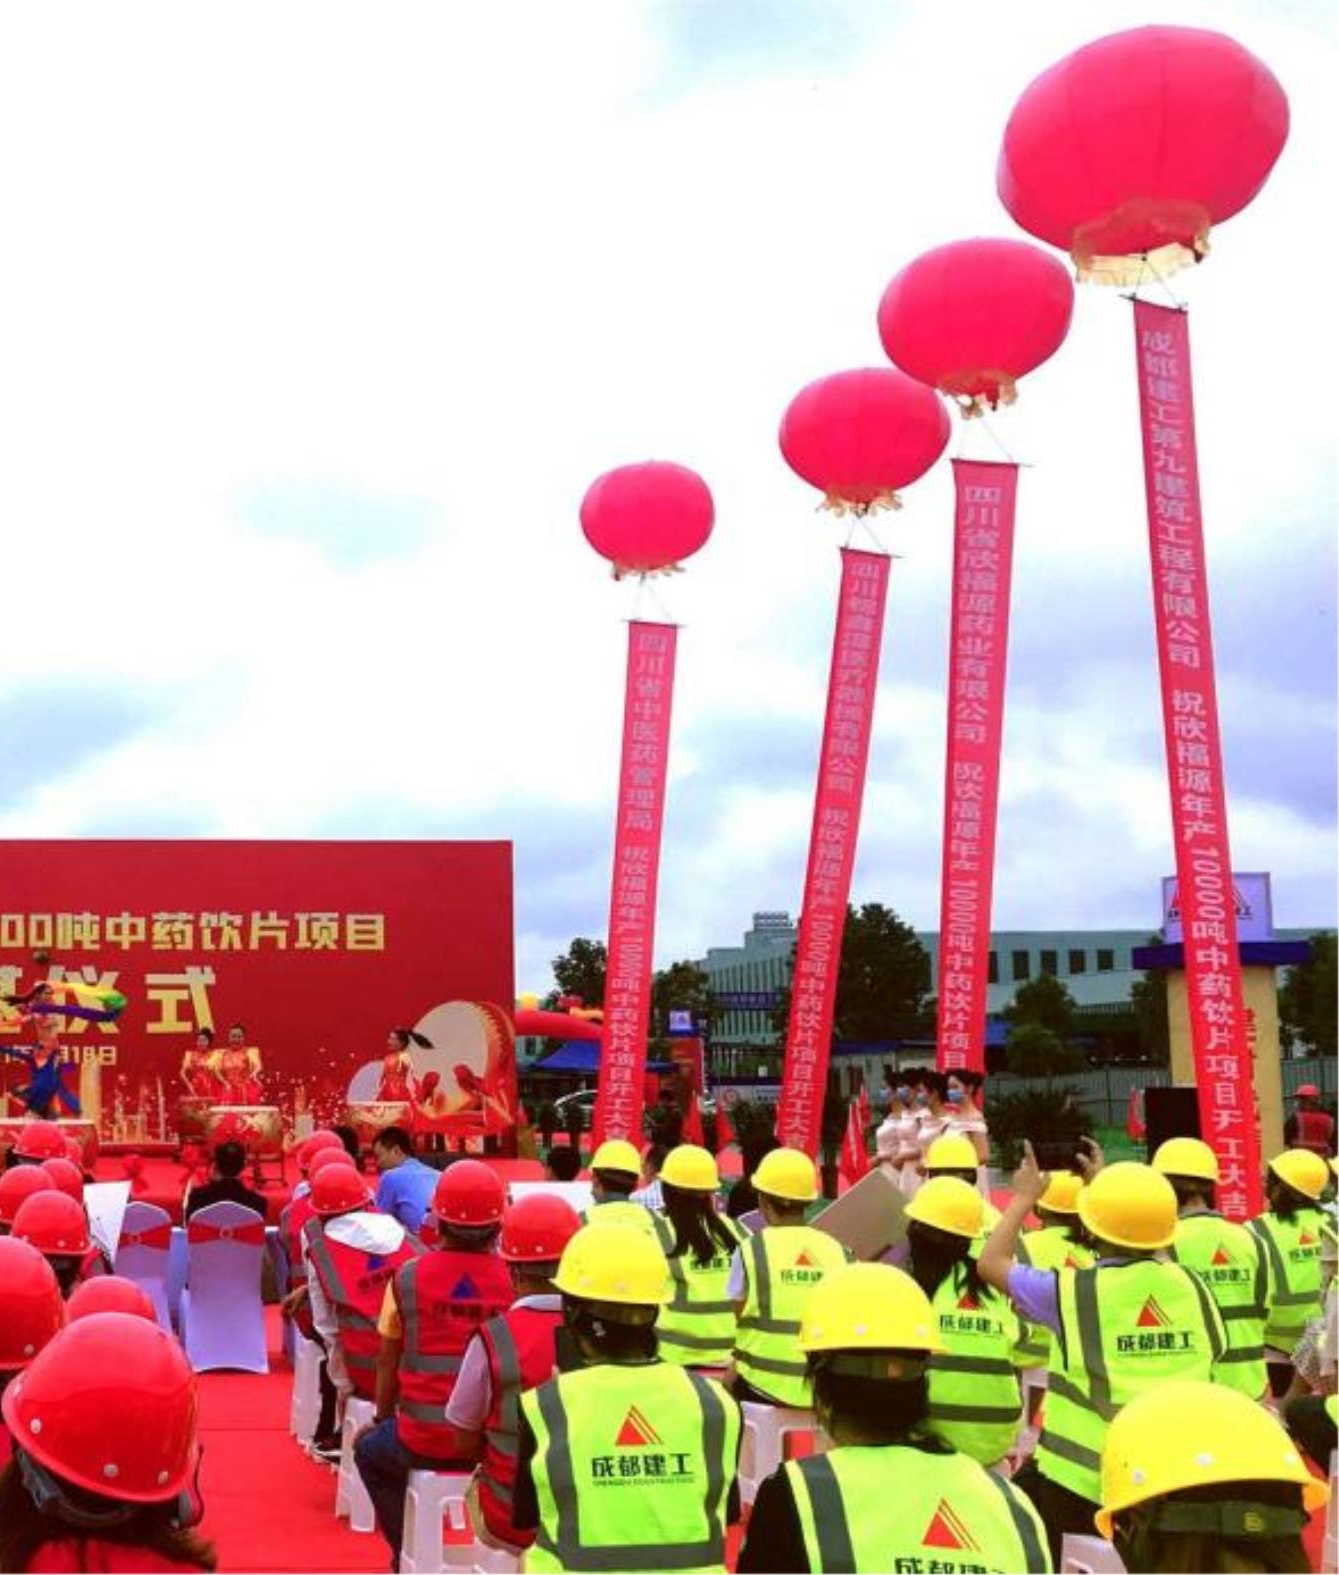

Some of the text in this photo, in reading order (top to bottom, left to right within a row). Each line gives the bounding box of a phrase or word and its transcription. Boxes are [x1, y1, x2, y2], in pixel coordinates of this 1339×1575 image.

[942, 487, 1001, 1070] 四川省欣福源药业有限公司 祝欣福源年产10000吨中药饮片项目
[1172, 689, 1247, 1216] 祝欣福源年产10000吨中药饮片项目开工大吉
[591, 1453, 694, 1477] 成都建工
[1116, 1331, 1196, 1352] 成都建工
